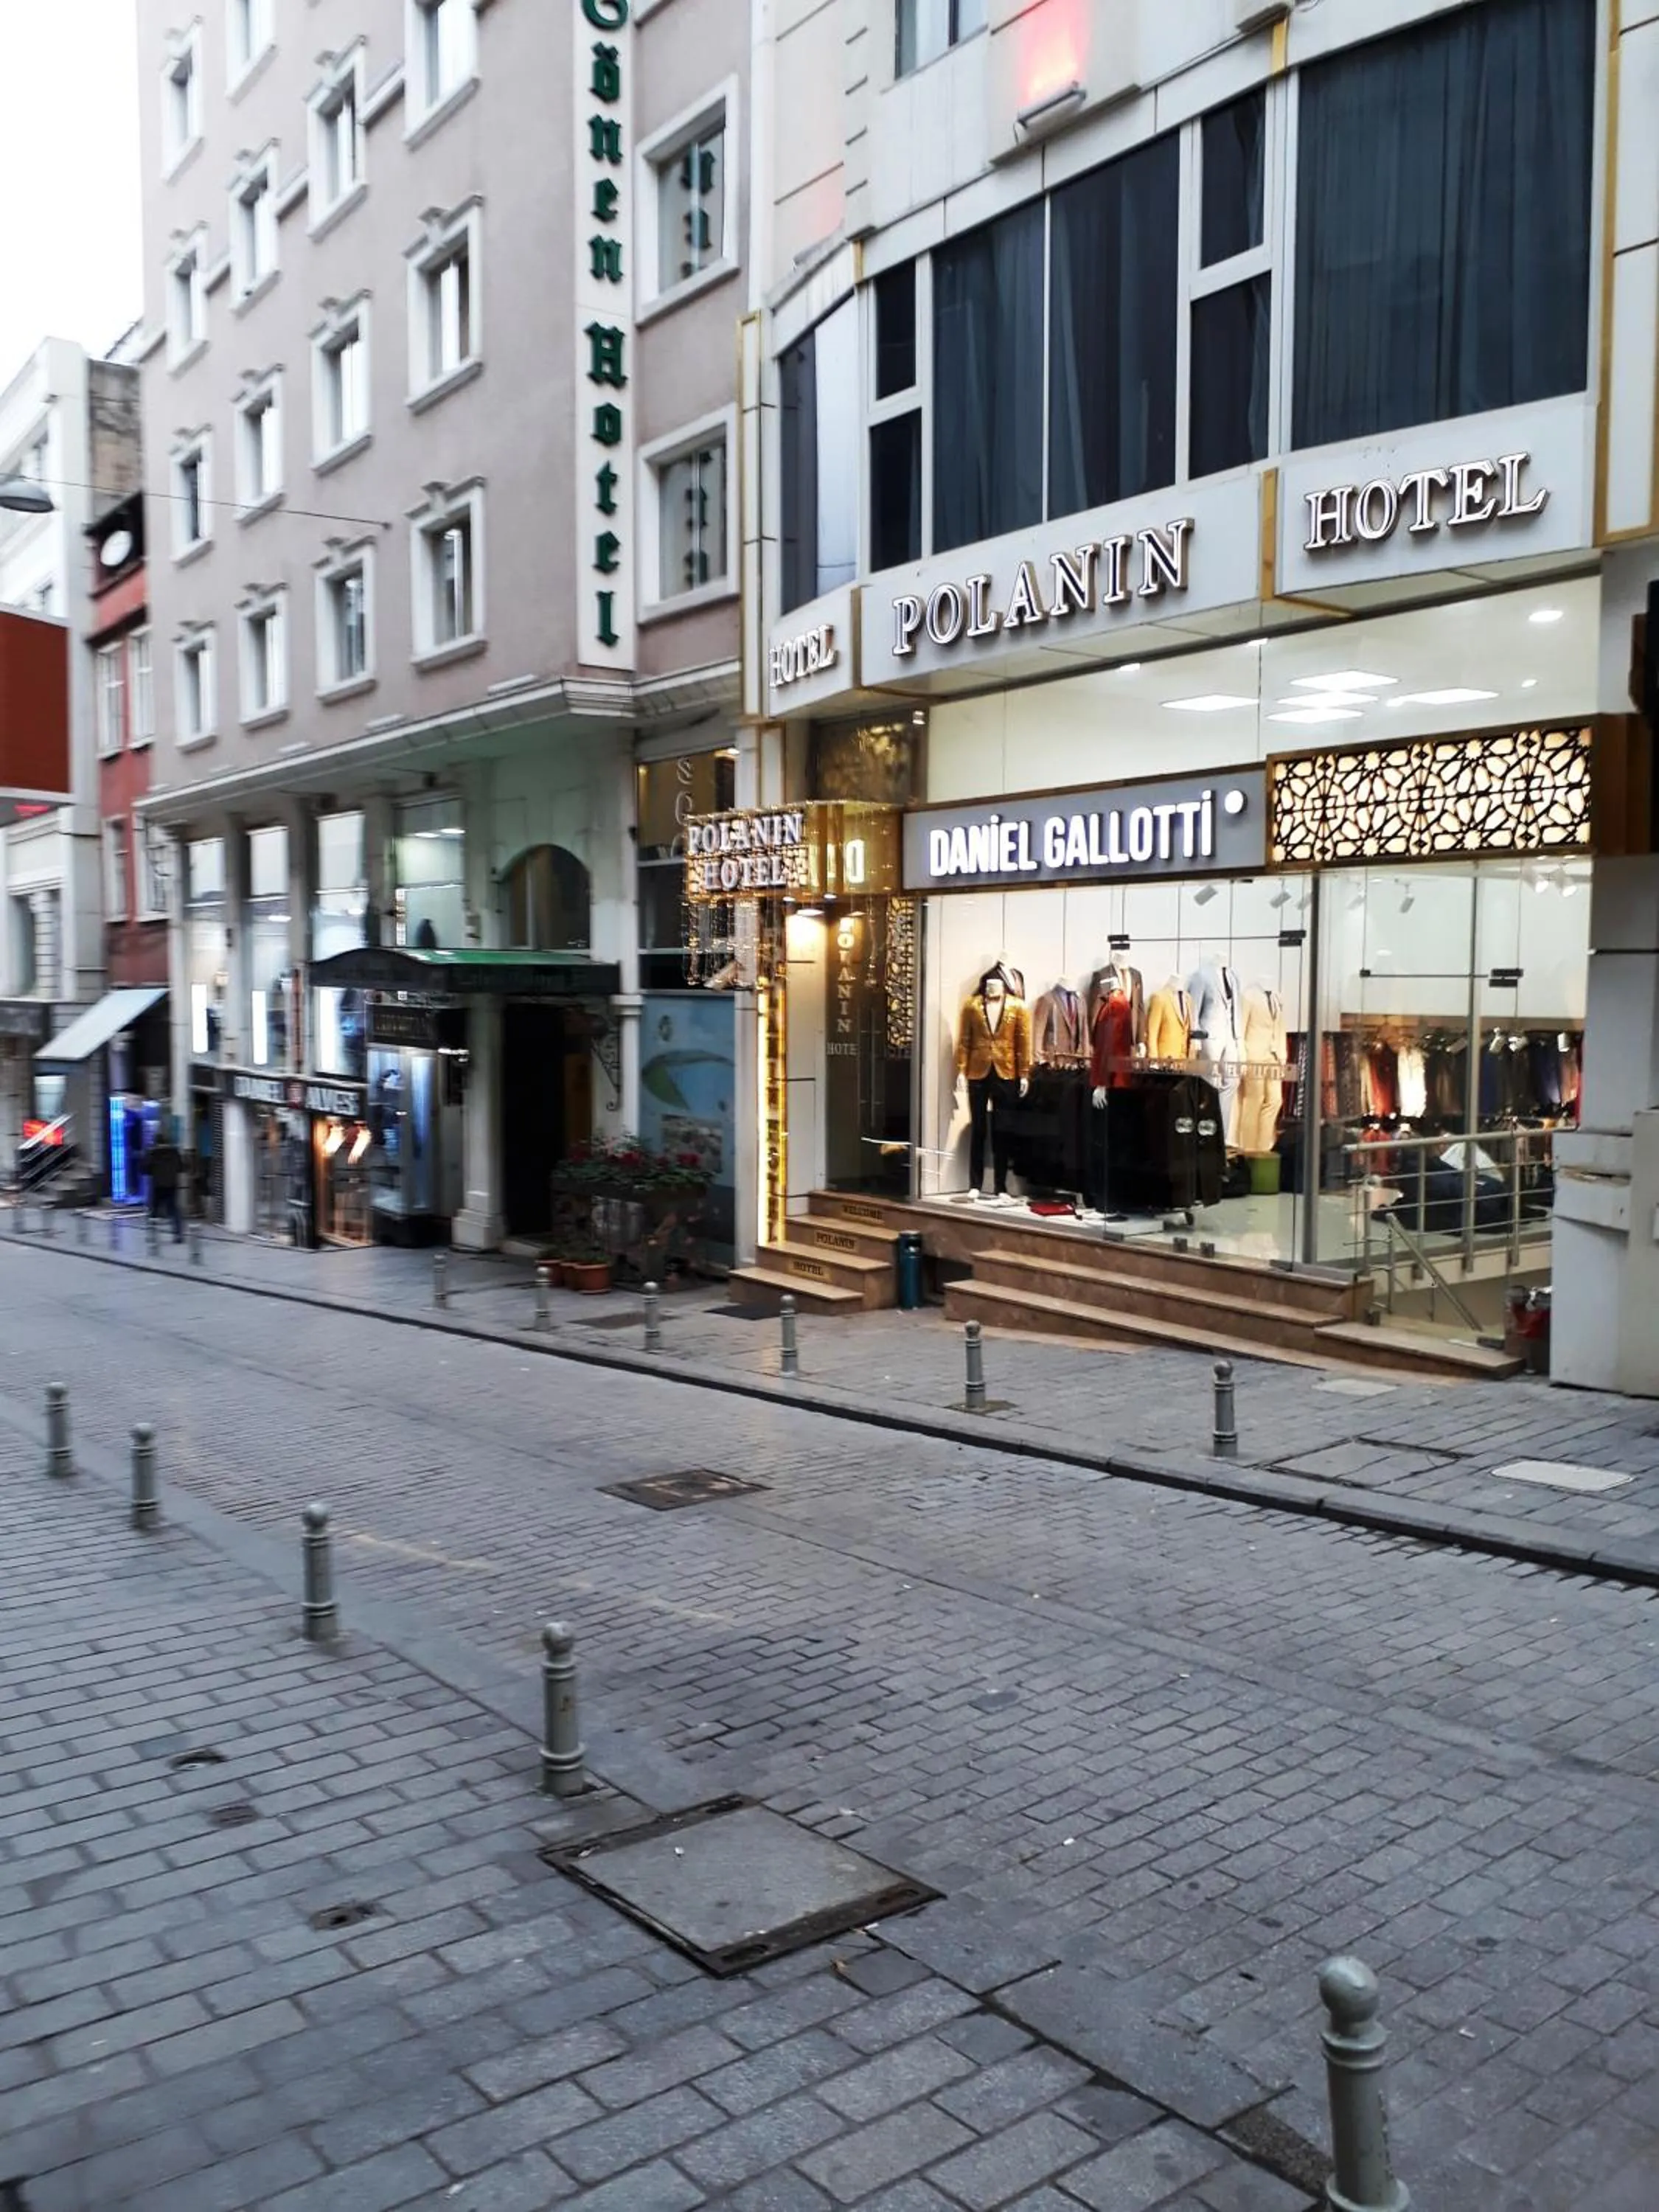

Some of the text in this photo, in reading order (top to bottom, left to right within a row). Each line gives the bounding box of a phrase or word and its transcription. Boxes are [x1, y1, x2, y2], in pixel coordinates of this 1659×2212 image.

[585, 320, 627, 649] Hotel
[1303, 451, 1548, 554] HOTEL
[892, 517, 1194, 656] POLANIN
[769, 625, 837, 688] HOTEL
[689, 813, 803, 856] POLANIN
[703, 855, 790, 891] HOTEL
